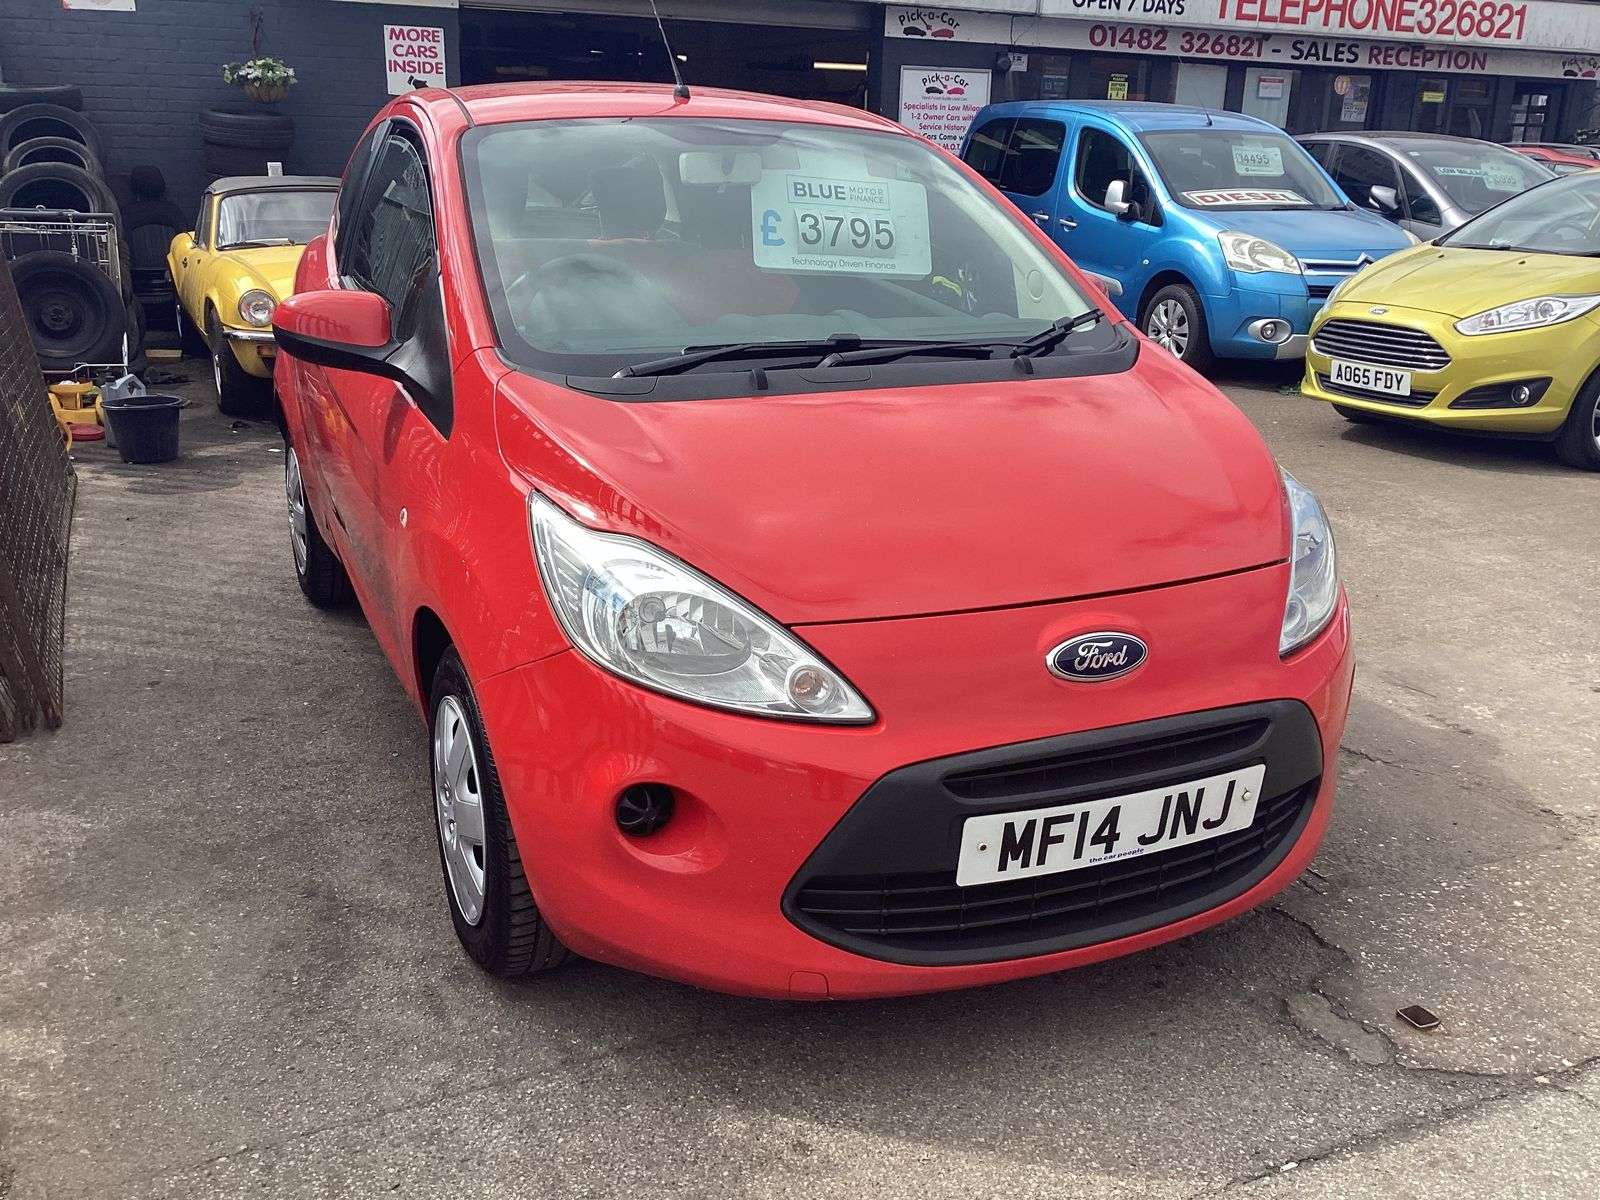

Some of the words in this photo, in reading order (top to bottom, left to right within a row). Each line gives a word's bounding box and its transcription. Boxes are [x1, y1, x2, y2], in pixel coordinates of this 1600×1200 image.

[1143, 0, 1185, 15] DAYS
[898, 9, 960, 28] Pick-a-Car
[389, 27, 440, 43] MORE
[392, 44, 438, 59] CARS
[1089, 24, 1168, 51] 01482
[1180, 31, 1264, 58] 326821
[1290, 39, 1359, 63] SALES
[1368, 46, 1487, 70] RECEPTION
[388, 60, 444, 75] INSIDE
[921, 73, 968, 88] Pick-a-Car
[903, 102, 938, 111] Specialists
[922, 113, 944, 121] Owner
[919, 123, 942, 131] Service
[944, 124, 967, 133] History
[939, 133, 957, 141] Come
[793, 182, 846, 200] BLUE
[848, 185, 884, 195] MOTOR
[1199, 192, 1301, 203] DIESEL
[849, 194, 884, 204] FINANCE
[761, 209, 786, 247] £
[800, 213, 894, 249] 3795
[791, 257, 838, 268] Technology
[840, 259, 864, 268] Driven
[865, 260, 896, 270] Finance
[1374, 370, 1404, 391] FDY
[1073, 640, 1129, 671] Ford
[997, 804, 1121, 873] MF14
[1137, 779, 1237, 846] JNJ
[1103, 853, 1117, 861] car
[1117, 847, 1145, 859] people
